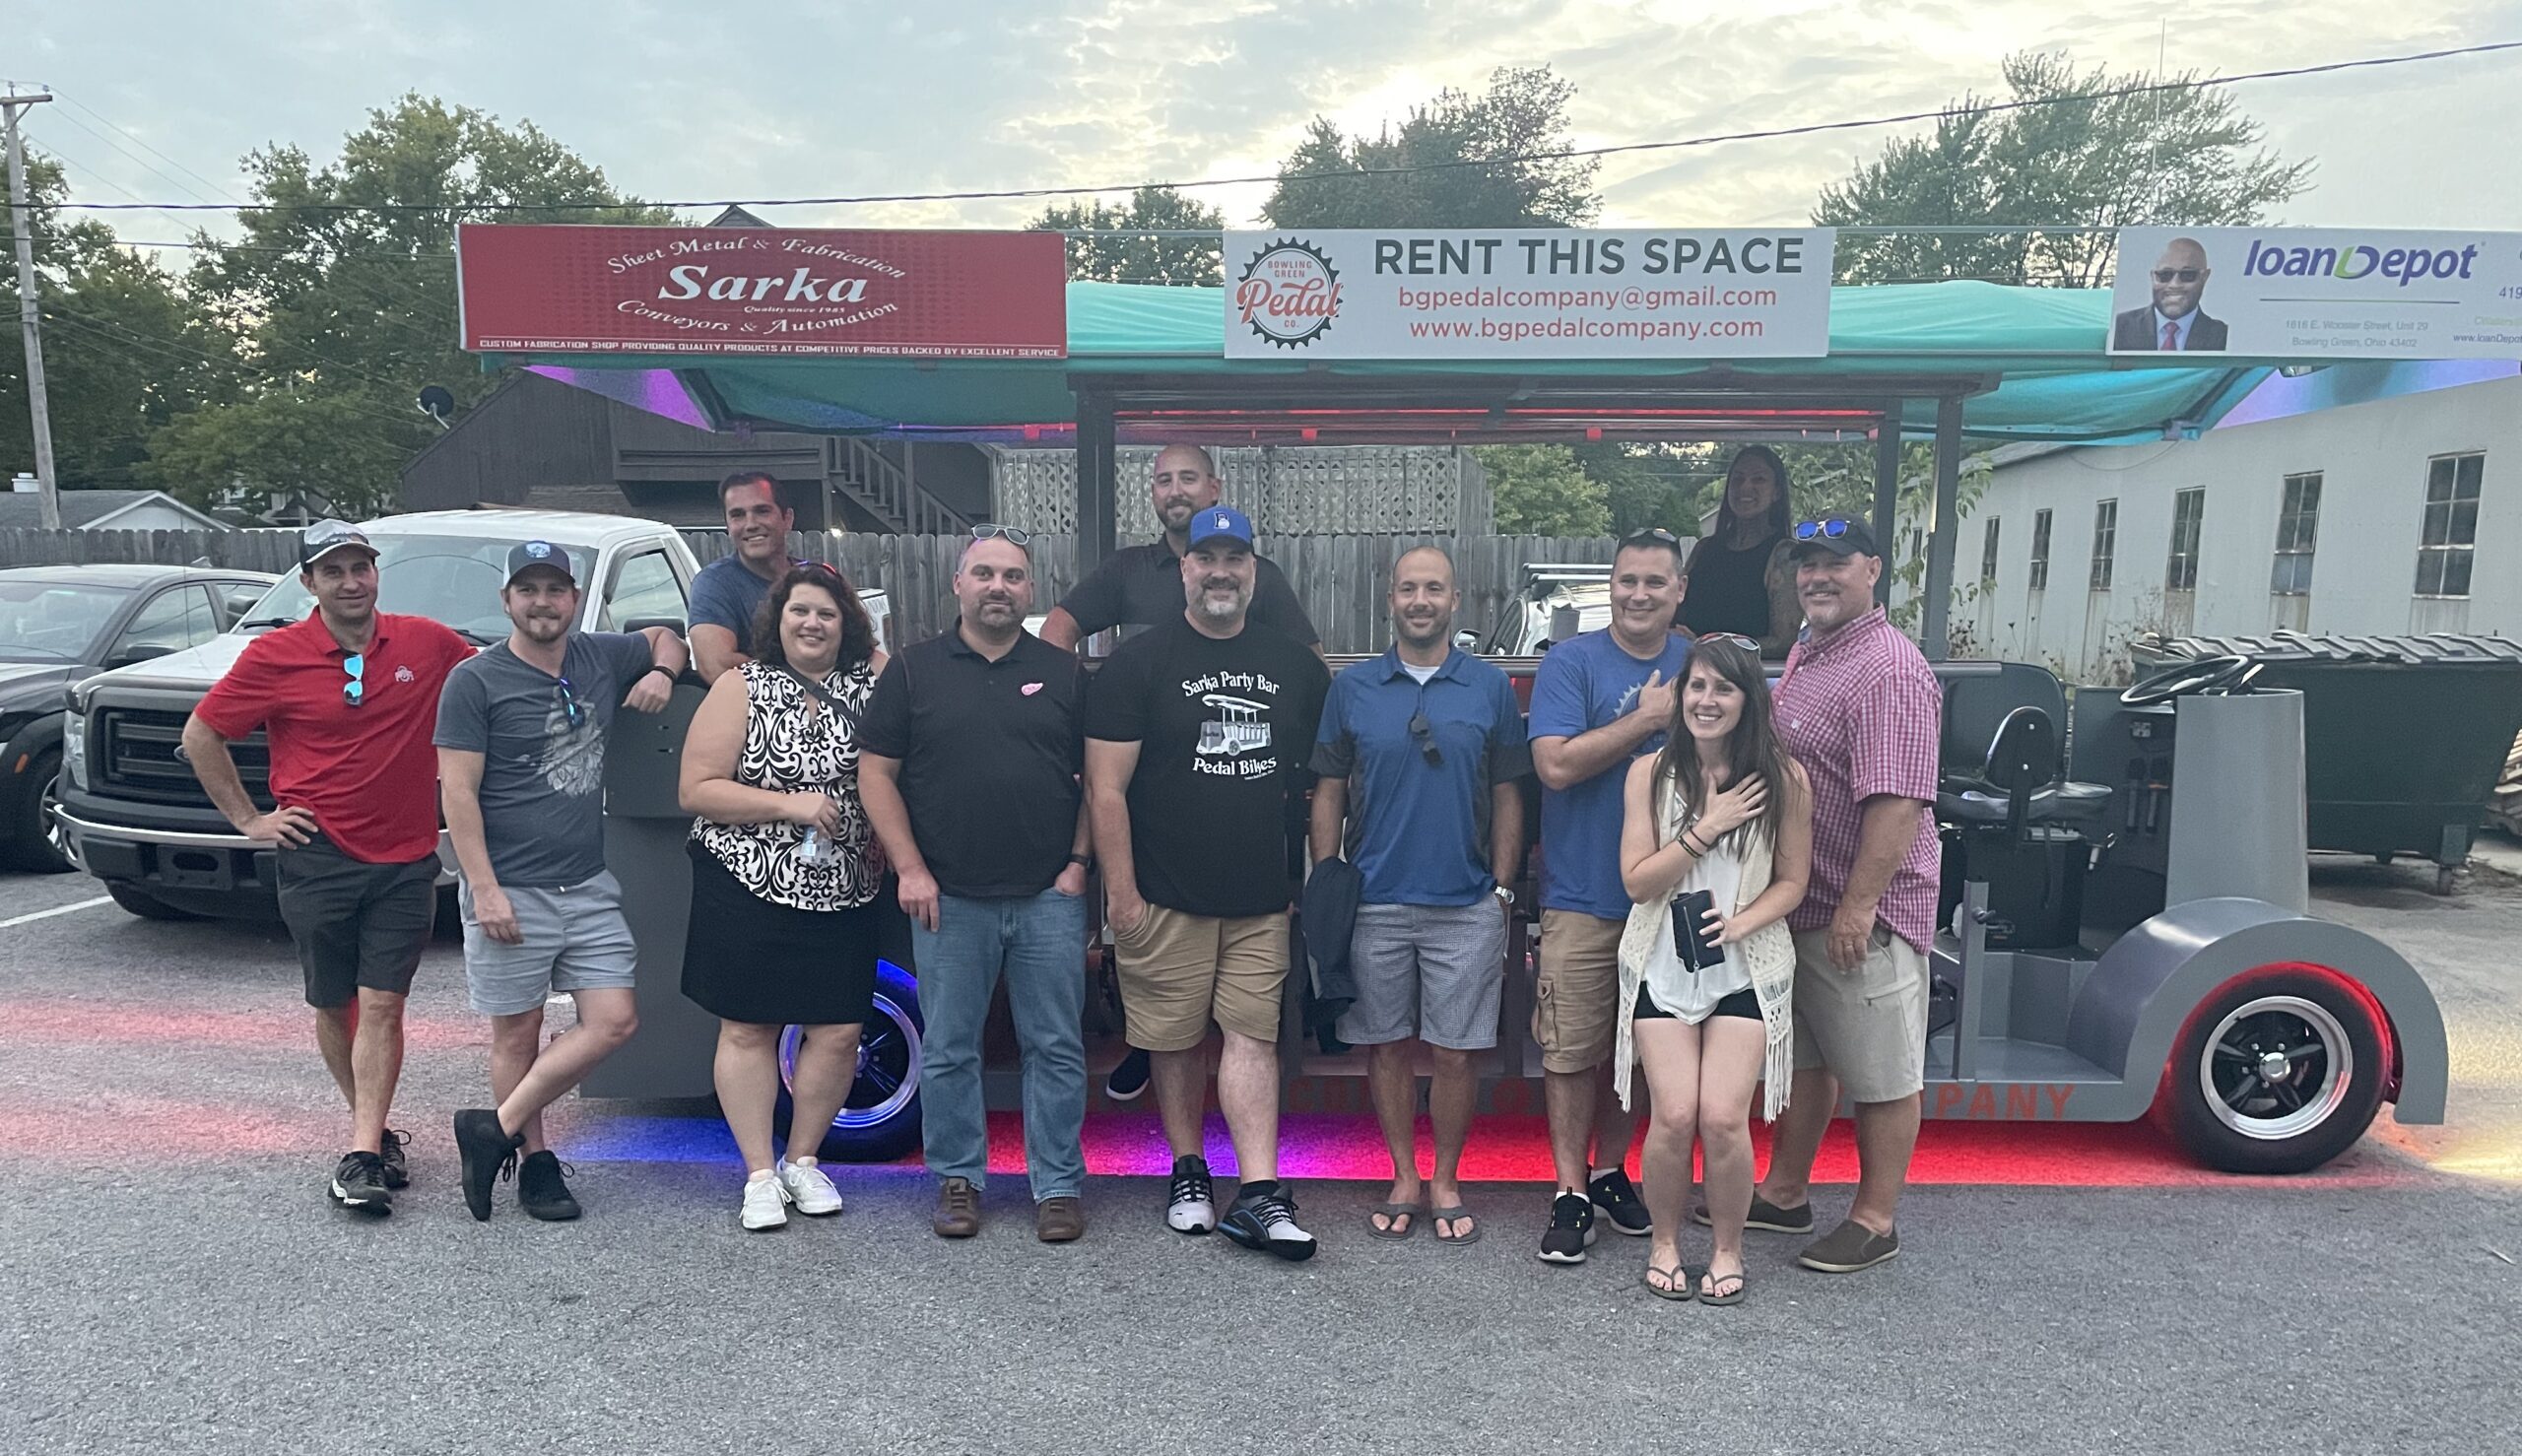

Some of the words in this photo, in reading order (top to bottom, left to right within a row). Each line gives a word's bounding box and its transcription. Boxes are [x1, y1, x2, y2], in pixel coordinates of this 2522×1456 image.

[607, 248, 666, 274] Sheet
[670, 236, 749, 255] Metal
[753, 238, 771, 249] &
[781, 238, 906, 279] Fabrication
[1268, 260, 1312, 269] BOWLING
[1375, 238, 1502, 275] RENT
[1518, 237, 1626, 275] THIS
[1642, 236, 1803, 274] SPACE
[2243, 239, 2478, 287] loanDepot
[658, 265, 868, 303] Sarka
[744, 305, 785, 314] Quality
[1236, 278, 1343, 324] Pedal
[1399, 284, 1777, 311] bgpedalcompany@gmail.com
[617, 299, 731, 329] Conveyors
[741, 322, 758, 332] &
[763, 302, 898, 335] Automation
[1410, 316, 1763, 341] www.bgpedalcompany.com
[480, 339, 522, 348] CUSTOM
[524, 340, 589, 349] FABRICATION
[591, 341, 619, 350] SHOP
[622, 342, 676, 351] PROVIDING
[678, 343, 720, 352] QUALITY
[724, 344, 778, 353] PRODUCTS
[780, 344, 792, 353] AT
[795, 345, 861, 354] COMPETITIVE
[863, 346, 898, 355] PRICES
[961, 348, 1015, 357] EXCELLENT
[2292, 337, 2328, 348] Bowling
[2364, 338, 2386, 347] Ohio
[1182, 674, 1220, 696] Sarka
[1220, 671, 1254, 692] Party
[1257, 674, 1280, 695] Bar
[1192, 758, 1235, 775] Pedal
[1238, 757, 1277, 775] Bikes
